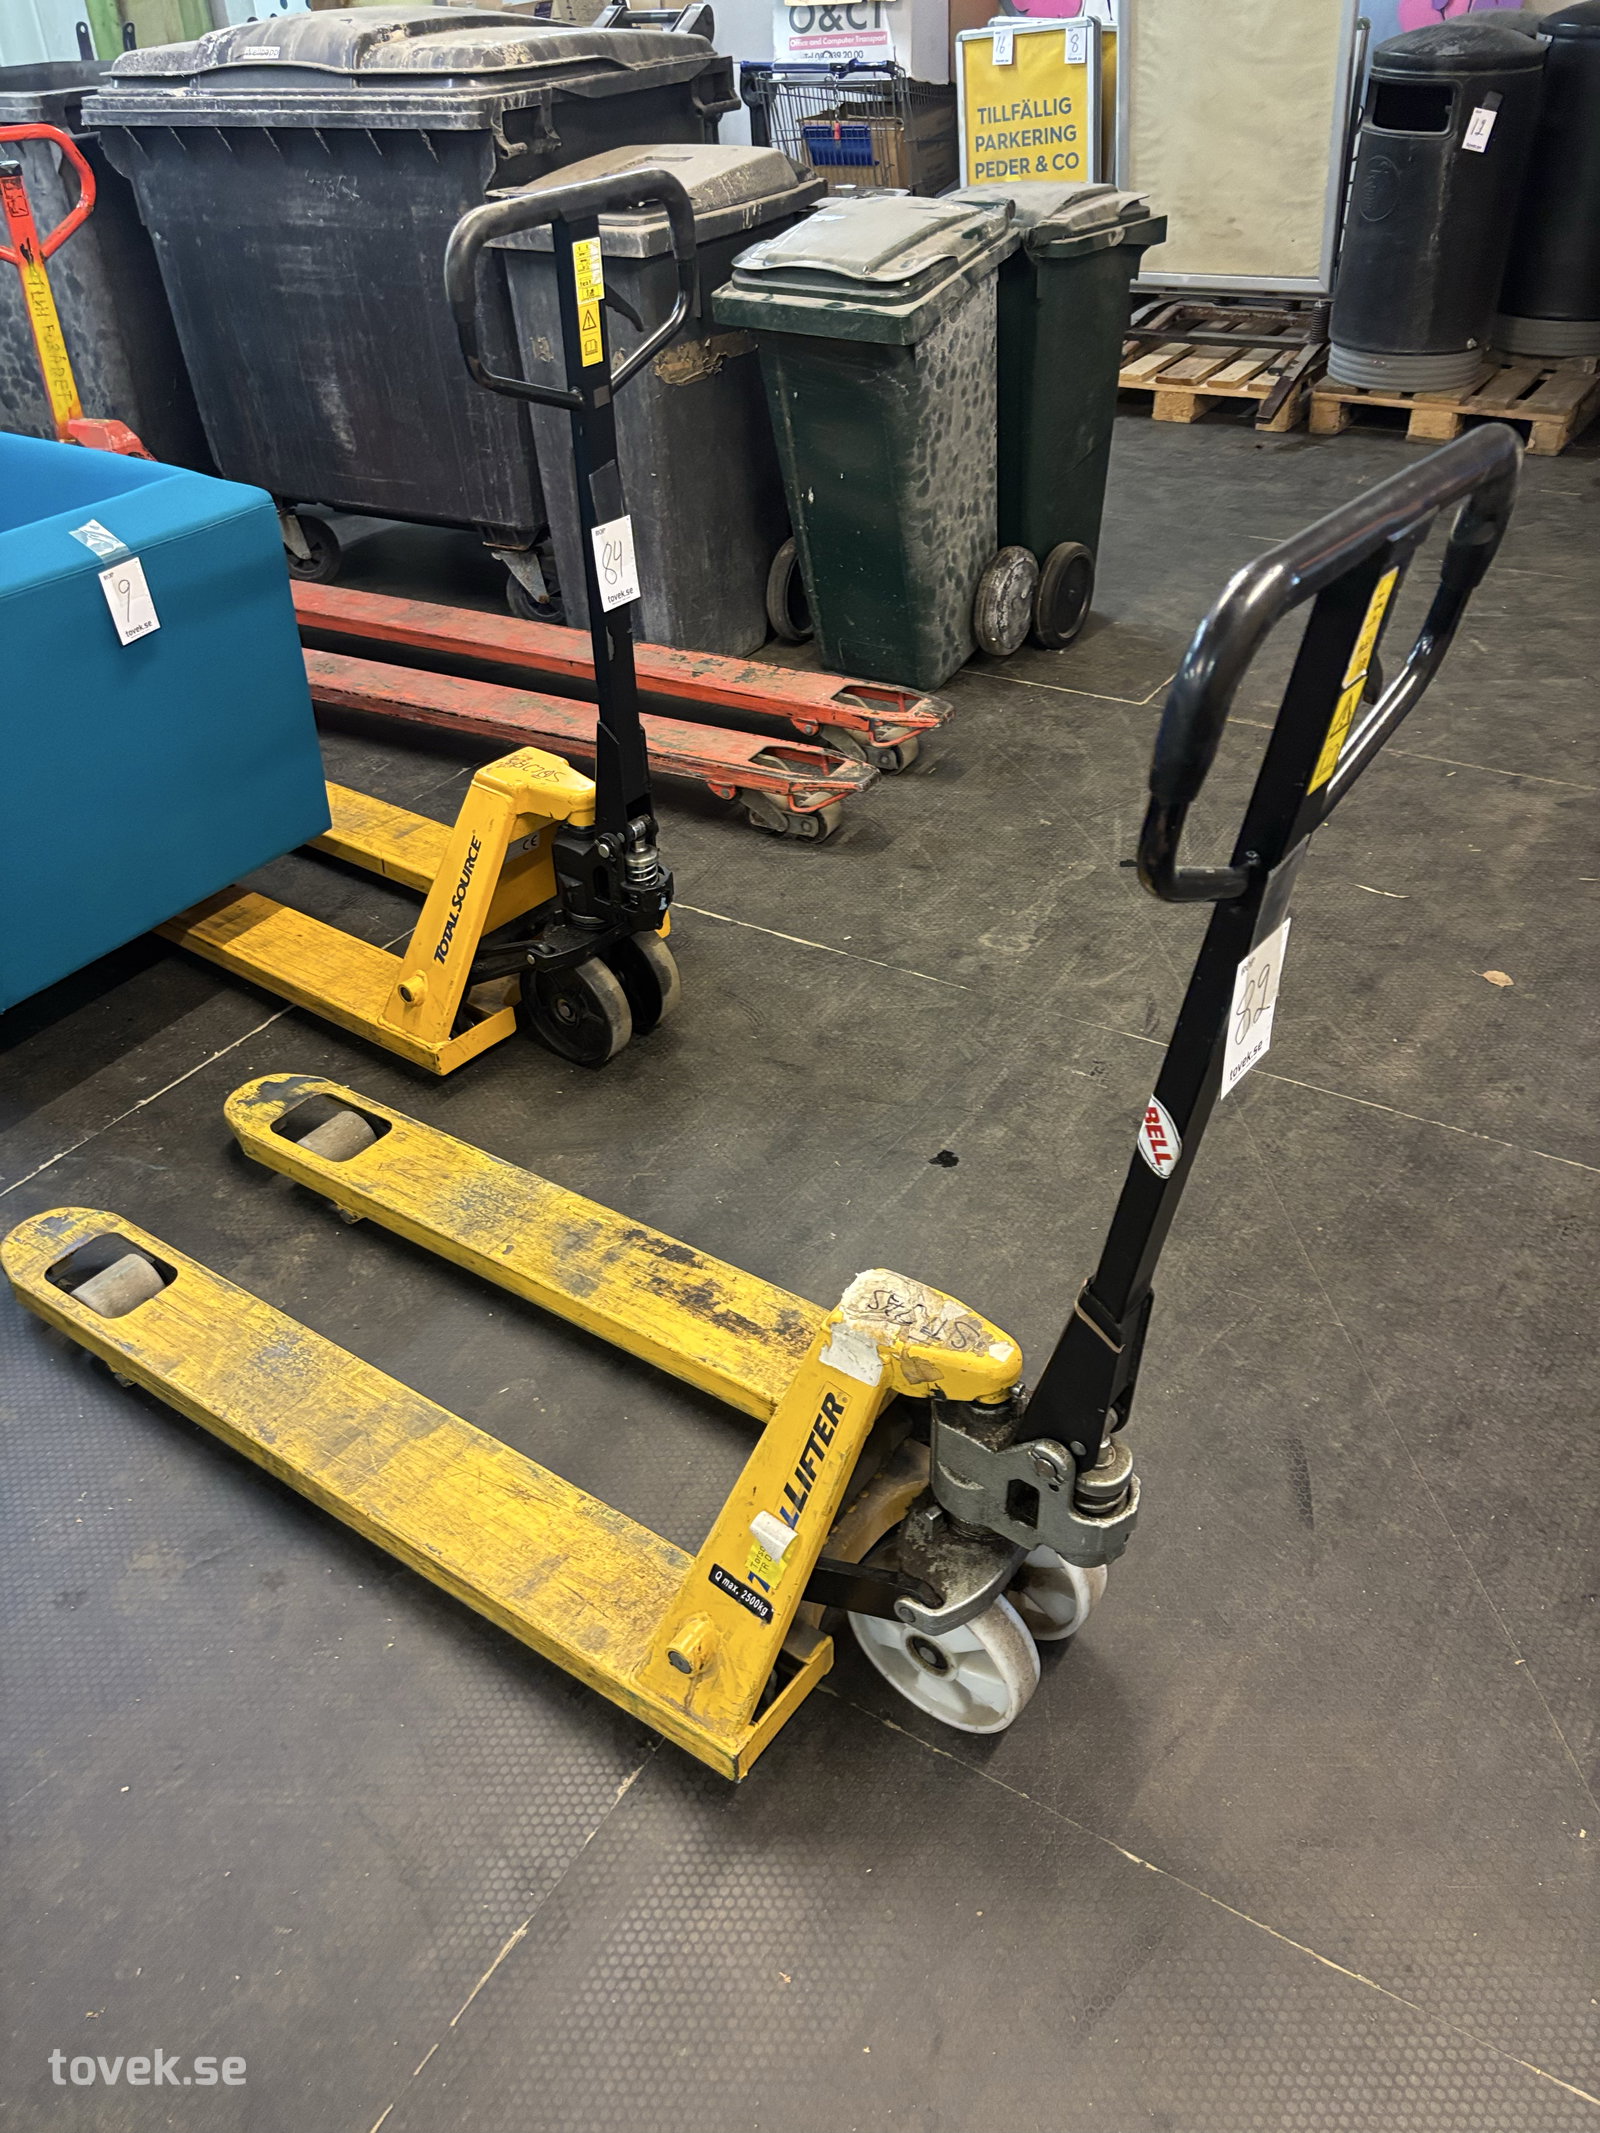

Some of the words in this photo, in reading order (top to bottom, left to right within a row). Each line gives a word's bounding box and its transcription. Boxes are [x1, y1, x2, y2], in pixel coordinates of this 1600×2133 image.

[790, 39, 808, 47] Office
[809, 37, 821, 46] and
[822, 36, 855, 46] Computer
[855, 34, 886, 44] Transport
[996, 35, 1006, 54] 16
[1071, 33, 1079, 53] 8
[977, 97, 1072, 124] TILLFÄLLIG
[975, 124, 1077, 152] PARKERING
[975, 157, 1031, 179] PEDER
[1035, 155, 1048, 173] &
[1052, 152, 1079, 171] CO
[602, 540, 623, 585] 84
[118, 579, 130, 623] 9
[607, 587, 634, 603] tovek.se
[125, 620, 153, 637] tovek.se
[1229, 1040, 1263, 1081] tovek.se
[714, 1570, 723, 1581] Q
[722, 1578, 739, 1595] max.
[740, 1590, 770, 1617] 2500kg
